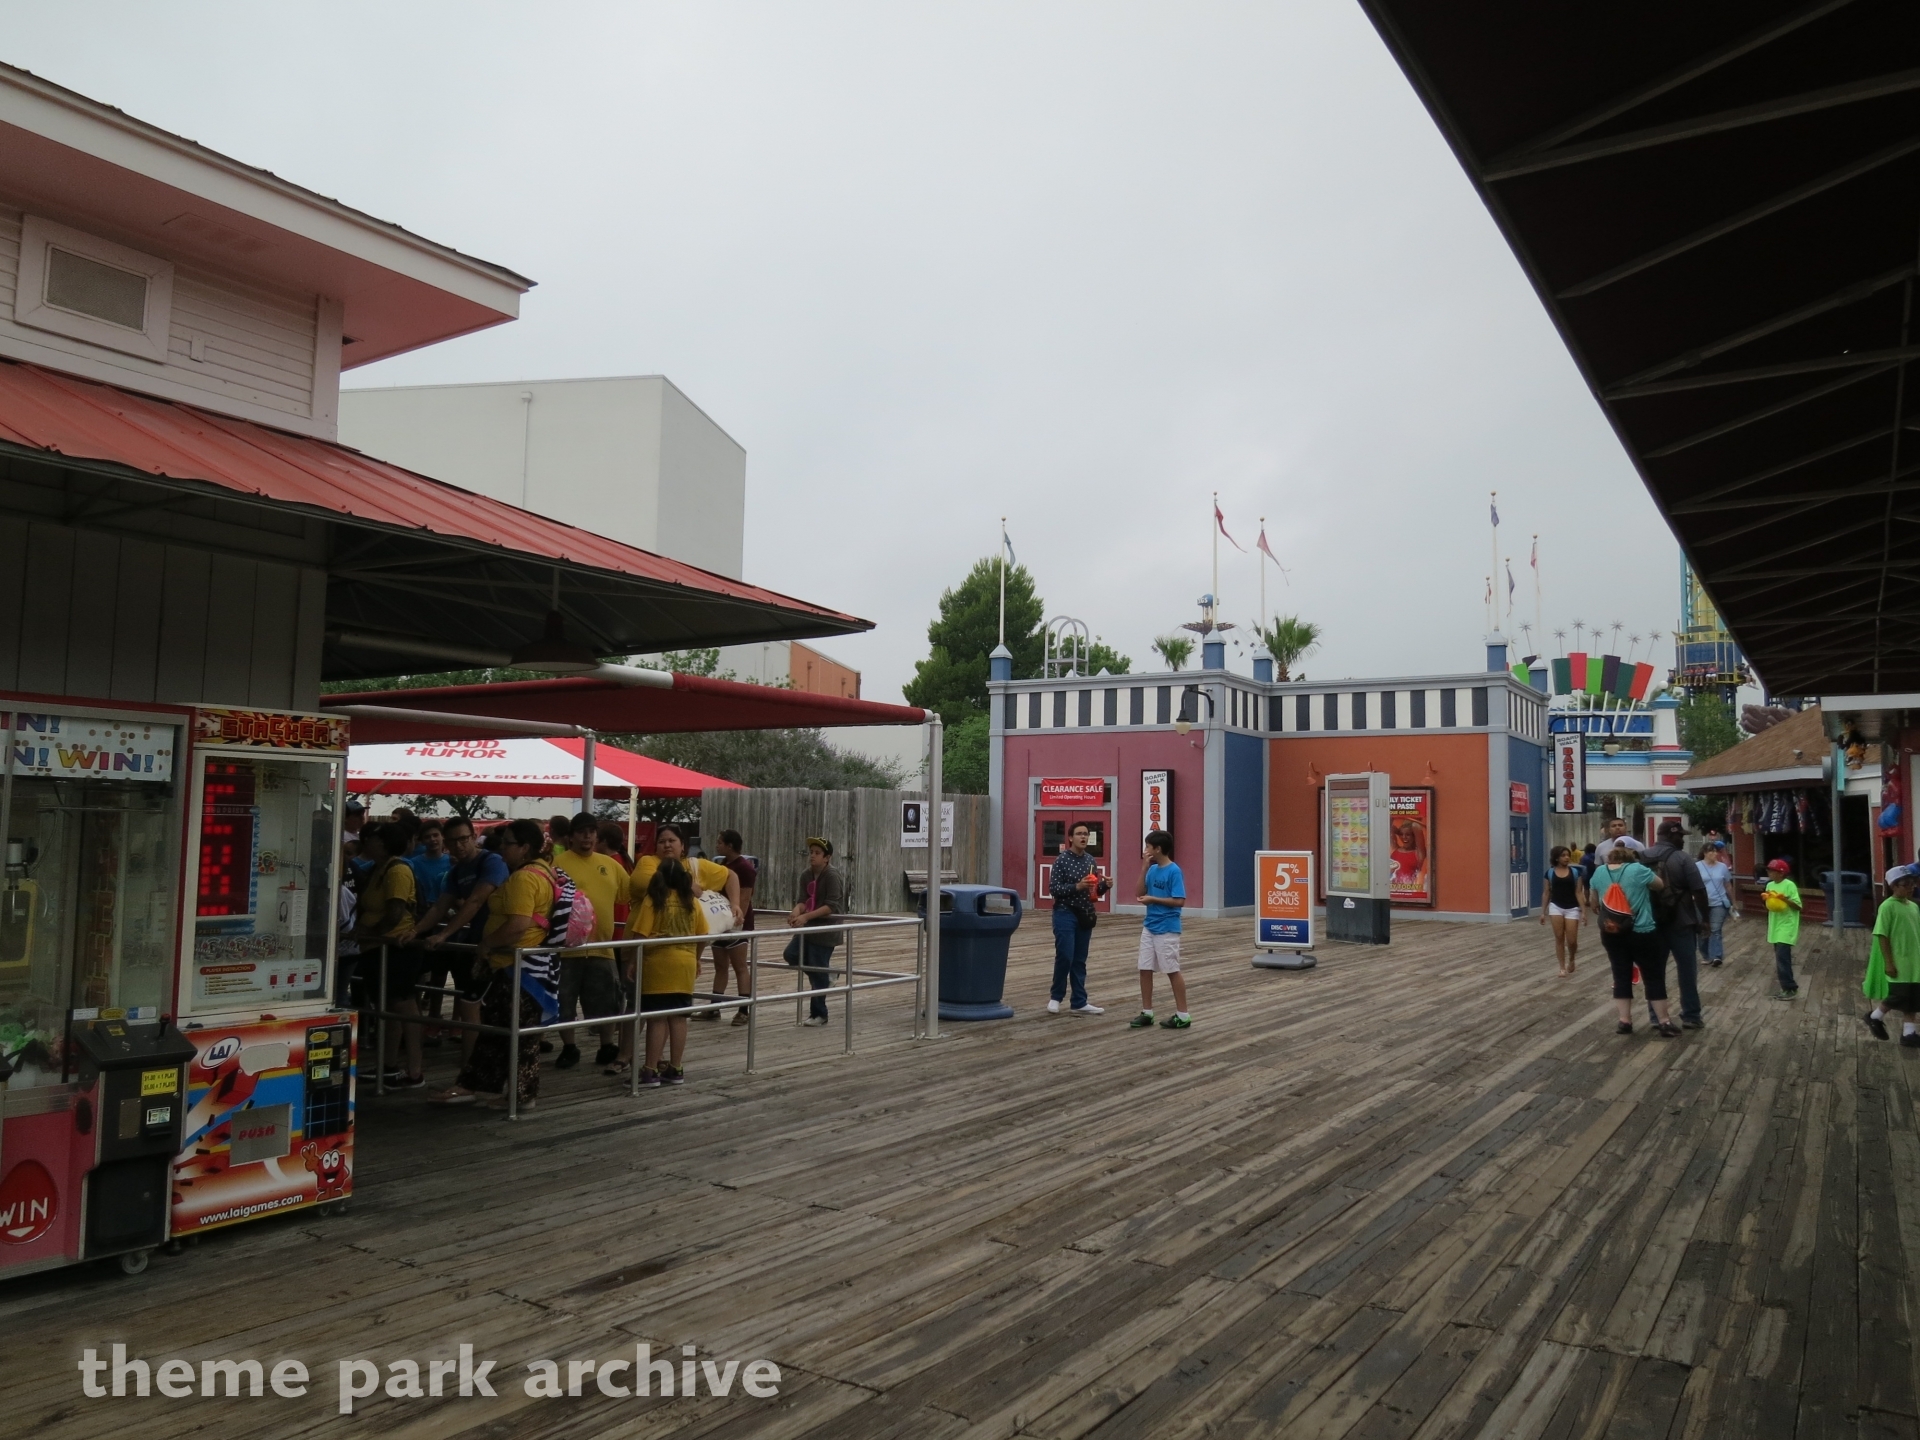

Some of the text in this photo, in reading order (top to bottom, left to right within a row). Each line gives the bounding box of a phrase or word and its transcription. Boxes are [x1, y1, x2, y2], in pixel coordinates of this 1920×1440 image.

[221, 717, 331, 744] STACKER
[424, 739, 500, 749] GOOD
[1556, 735, 1579, 743] BOARD
[58, 748, 154, 773] WIN!
[404, 747, 507, 759] HUMOR
[1144, 773, 1166, 781] BOARD
[1562, 747, 1575, 811] BARGAINS
[1042, 785, 1104, 793] CLEARANCE SALE
[1149, 786, 1161, 831] BARGA
[344, 878, 355, 888] not
[1274, 863, 1300, 890] 5%
[1268, 890, 1299, 898] CASHBACK
[1268, 896, 1300, 906] BONUS
[209, 1044, 232, 1060] LAI
[239, 1125, 276, 1141] PUSH
[0, 1196, 49, 1228] WIN
[200, 1194, 304, 1225] www.laigames.com
